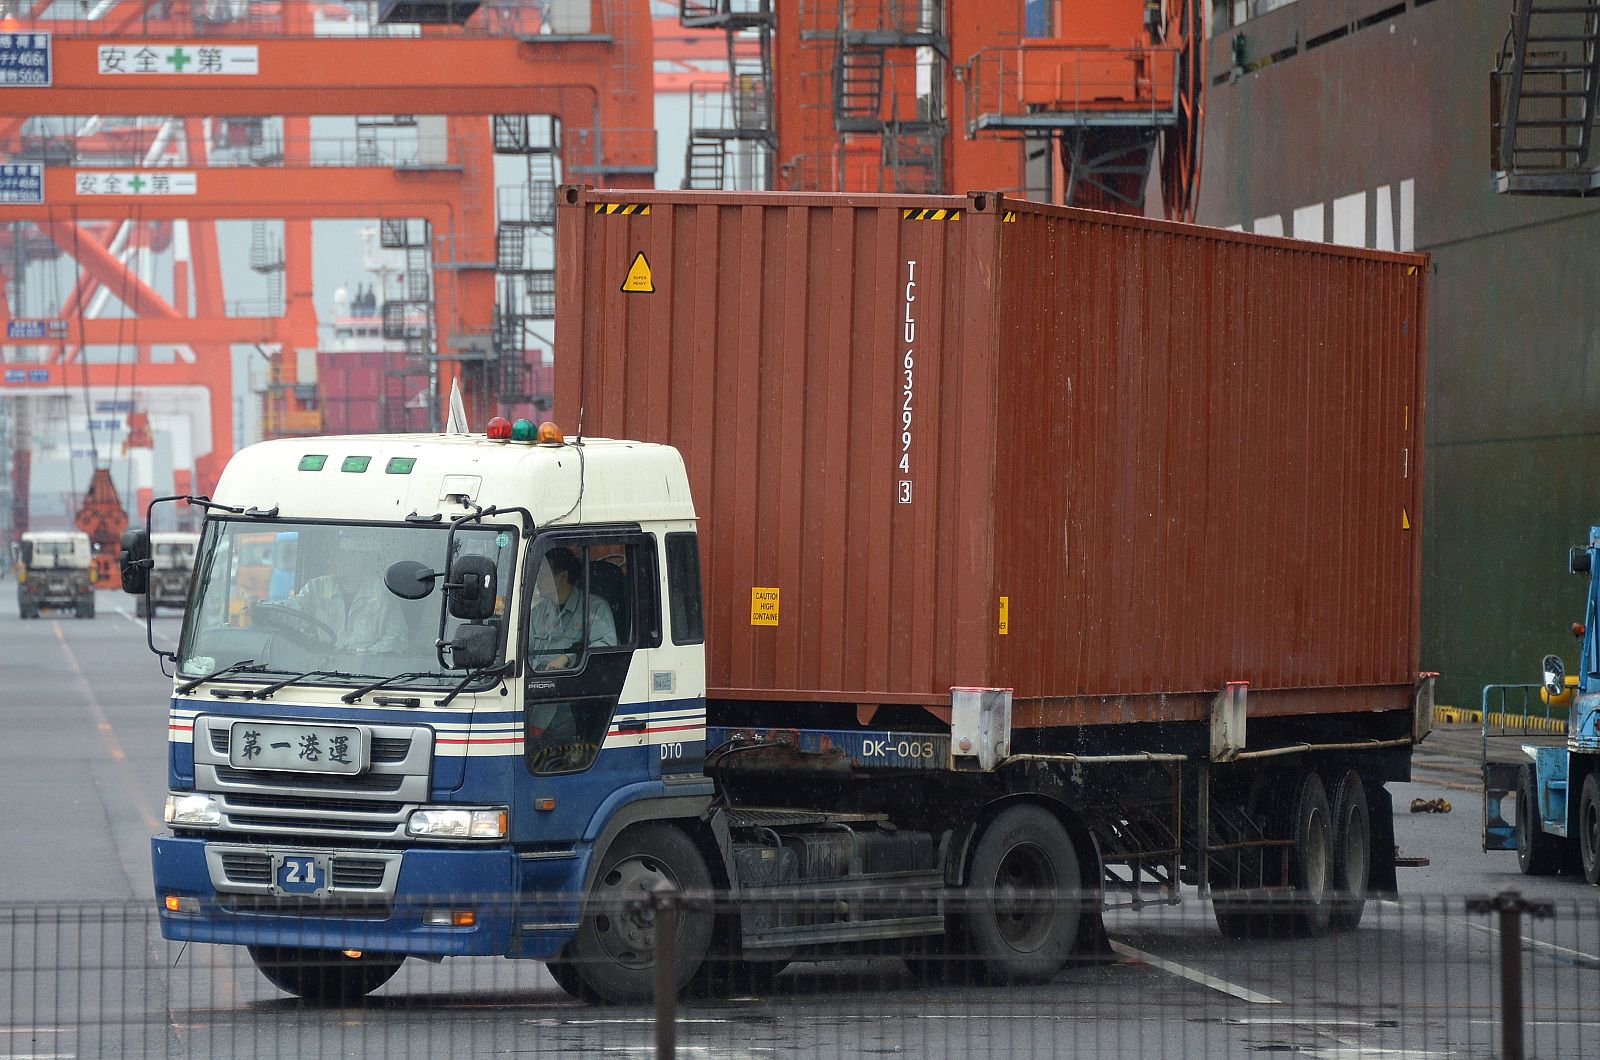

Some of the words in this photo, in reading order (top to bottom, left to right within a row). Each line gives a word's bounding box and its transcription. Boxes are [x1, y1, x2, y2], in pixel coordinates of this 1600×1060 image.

[904, 260, 917, 343] TCLU
[899, 349, 914, 474] 632994
[760, 602, 775, 610] HIGH
[241, 730, 353, 765] 第一港運
[862, 740, 934, 758] DK-003
[286, 861, 316, 883] 21
